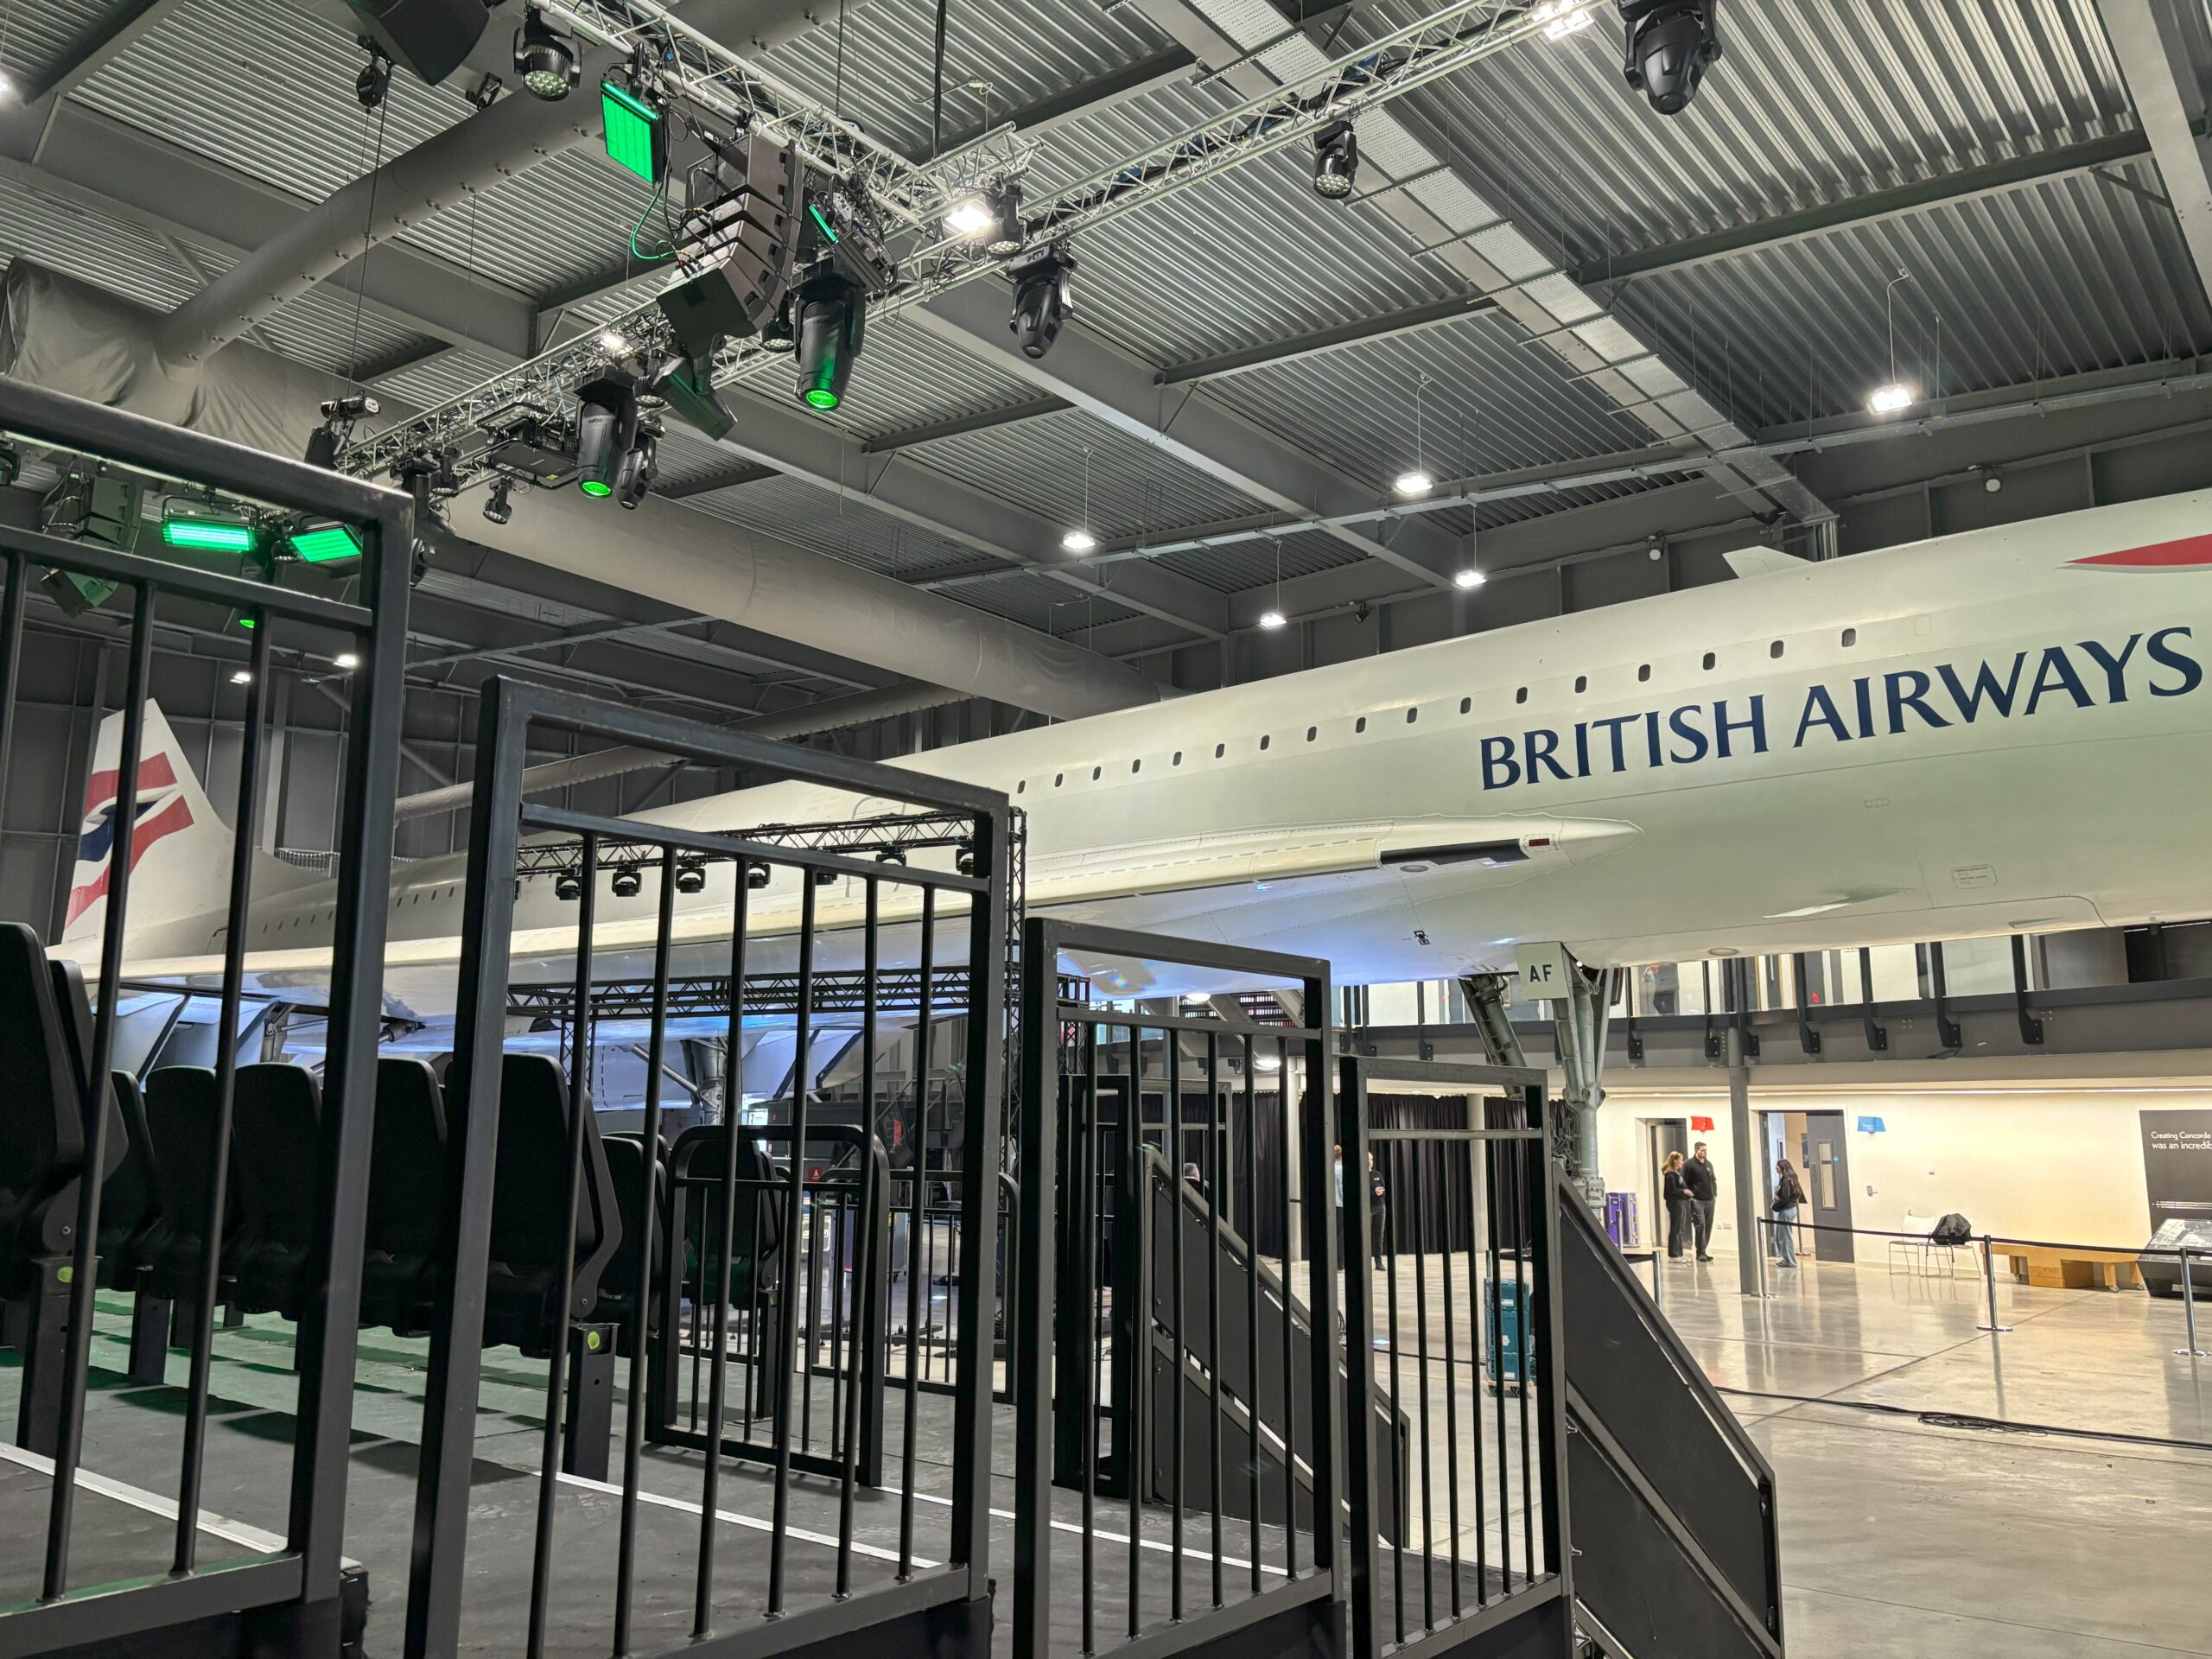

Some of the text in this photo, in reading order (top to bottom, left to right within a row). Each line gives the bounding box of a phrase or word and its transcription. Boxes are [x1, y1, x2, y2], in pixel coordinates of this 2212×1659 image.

[1481, 626, 2202, 789] BRITISH AIRWAYS
[1529, 964, 1552, 982] AF
[2151, 1131, 2178, 1141] Creating
